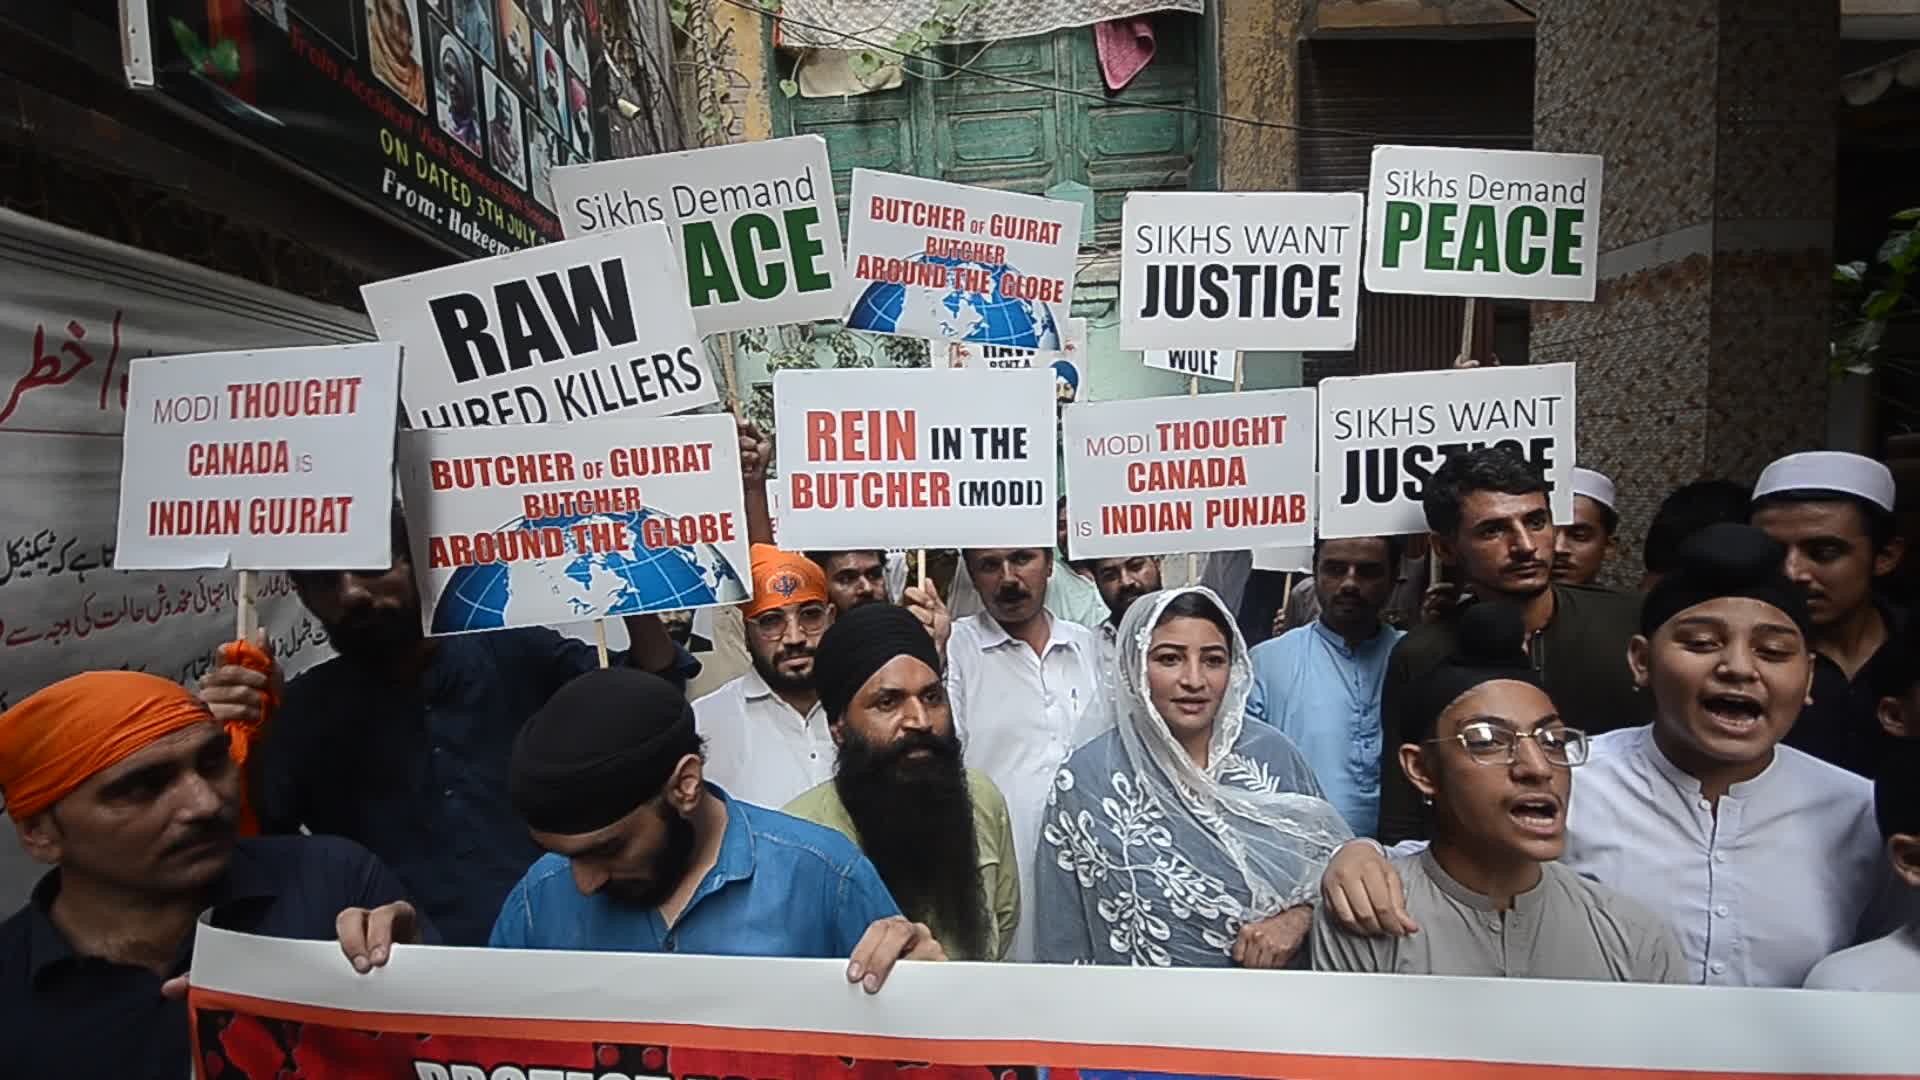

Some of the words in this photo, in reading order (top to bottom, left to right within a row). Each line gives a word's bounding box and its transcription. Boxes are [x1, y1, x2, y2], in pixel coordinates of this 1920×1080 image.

[380, 128, 409, 167] ON
[416, 152, 471, 207] DATED
[477, 195, 505, 229] 3TH
[507, 213, 537, 247] JULY
[382, 168, 444, 224] From:
[576, 190, 664, 231] Sikhs
[672, 166, 817, 218] Demand
[1386, 170, 1457, 198] Sikhs
[1468, 173, 1586, 204] Demand
[870, 196, 966, 233] BUTCHER
[970, 219, 986, 235] OF
[990, 214, 1063, 245] GUJRAT
[1136, 225, 1232, 254] SIKHS
[1244, 225, 1350, 254] WANT
[1382, 200, 1585, 275] PEACE
[683, 207, 832, 307] ACE
[926, 236, 1006, 265] BUTCHER
[855, 255, 947, 289] AROUND
[954, 267, 991, 294] THE
[1000, 273, 1065, 303] GLOBE
[1140, 263, 1341, 319] JUSTICE
[429, 257, 639, 384] RAW
[153, 396, 218, 424] MODI
[227, 377, 362, 420] THOUGHT
[553, 346, 702, 422] KILLERS
[807, 410, 916, 462] REIN
[931, 427, 961, 460] IN
[971, 427, 1028, 460] THE
[1087, 434, 1149, 456] MODI
[1156, 415, 1287, 452] THOUGHT
[1334, 405, 1436, 440] SIKHS
[1449, 397, 1561, 432] WANT
[188, 440, 289, 476] CANADA
[295, 455, 313, 473] IS
[430, 453, 575, 490] BUTCHER
[583, 461, 604, 480] OF
[610, 443, 713, 477] GUJRAT
[1128, 456, 1246, 492] CANADA
[1341, 437, 1554, 505] JUSE
[523, 487, 641, 519] BUTCHER
[791, 471, 951, 510] BUTCHER
[959, 480, 1043, 507] (MODI)
[148, 499, 240, 537] INDIAN
[250, 496, 353, 535] GUJRAT
[1075, 522, 1092, 537] IS
[1102, 501, 1193, 535] INDIAN
[1206, 494, 1306, 529] PUNJAB
[429, 531, 565, 568] AROUND
[571, 522, 630, 555] THE
[642, 512, 736, 550] GLOBE
